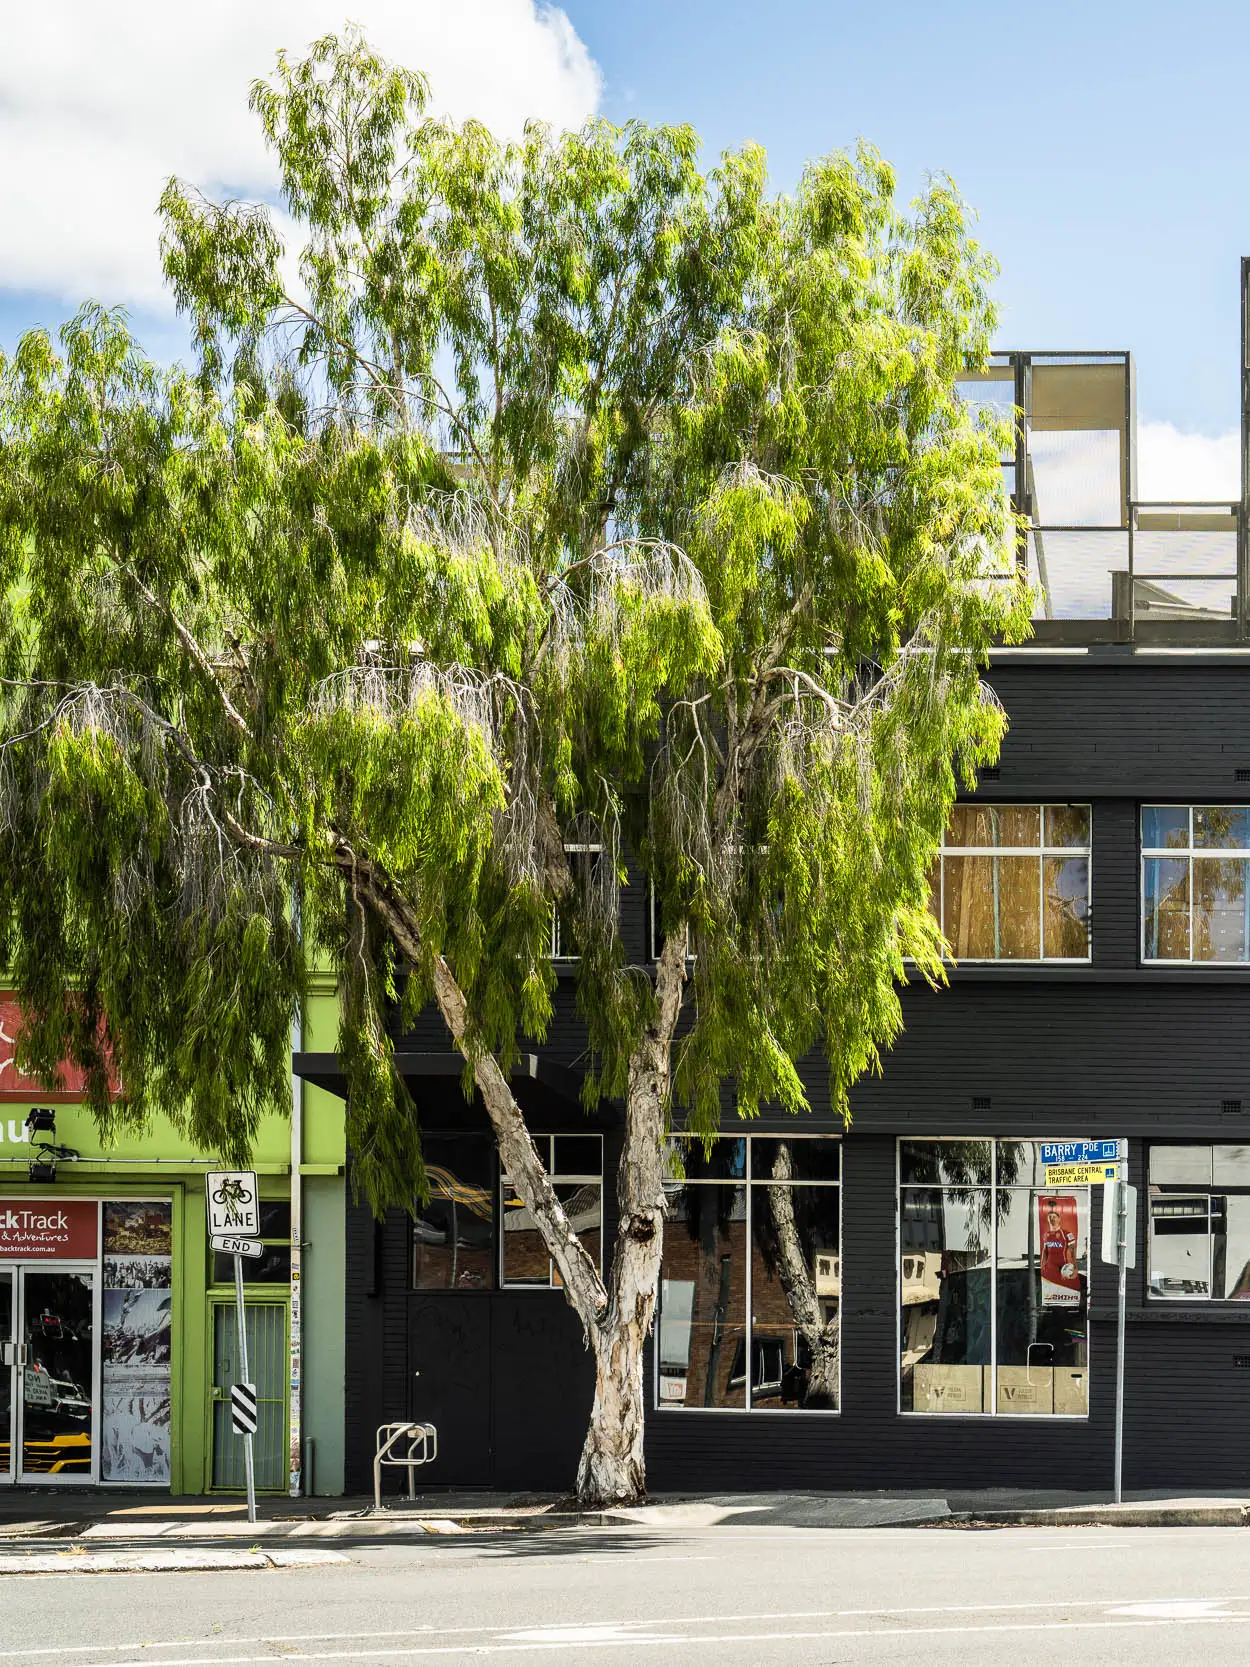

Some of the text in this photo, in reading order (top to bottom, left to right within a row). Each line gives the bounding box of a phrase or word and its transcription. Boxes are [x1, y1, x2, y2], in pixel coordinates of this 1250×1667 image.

[1044, 1143, 1077, 1157] BARRY
[1048, 1166, 1103, 1176] BRISBANE CENTRAL
[1048, 1175, 1089, 1184] TRAFFIC AREA
[213, 1212, 254, 1227] LANE
[1, 1230, 12, 1241] &
[222, 1239, 250, 1252] END
